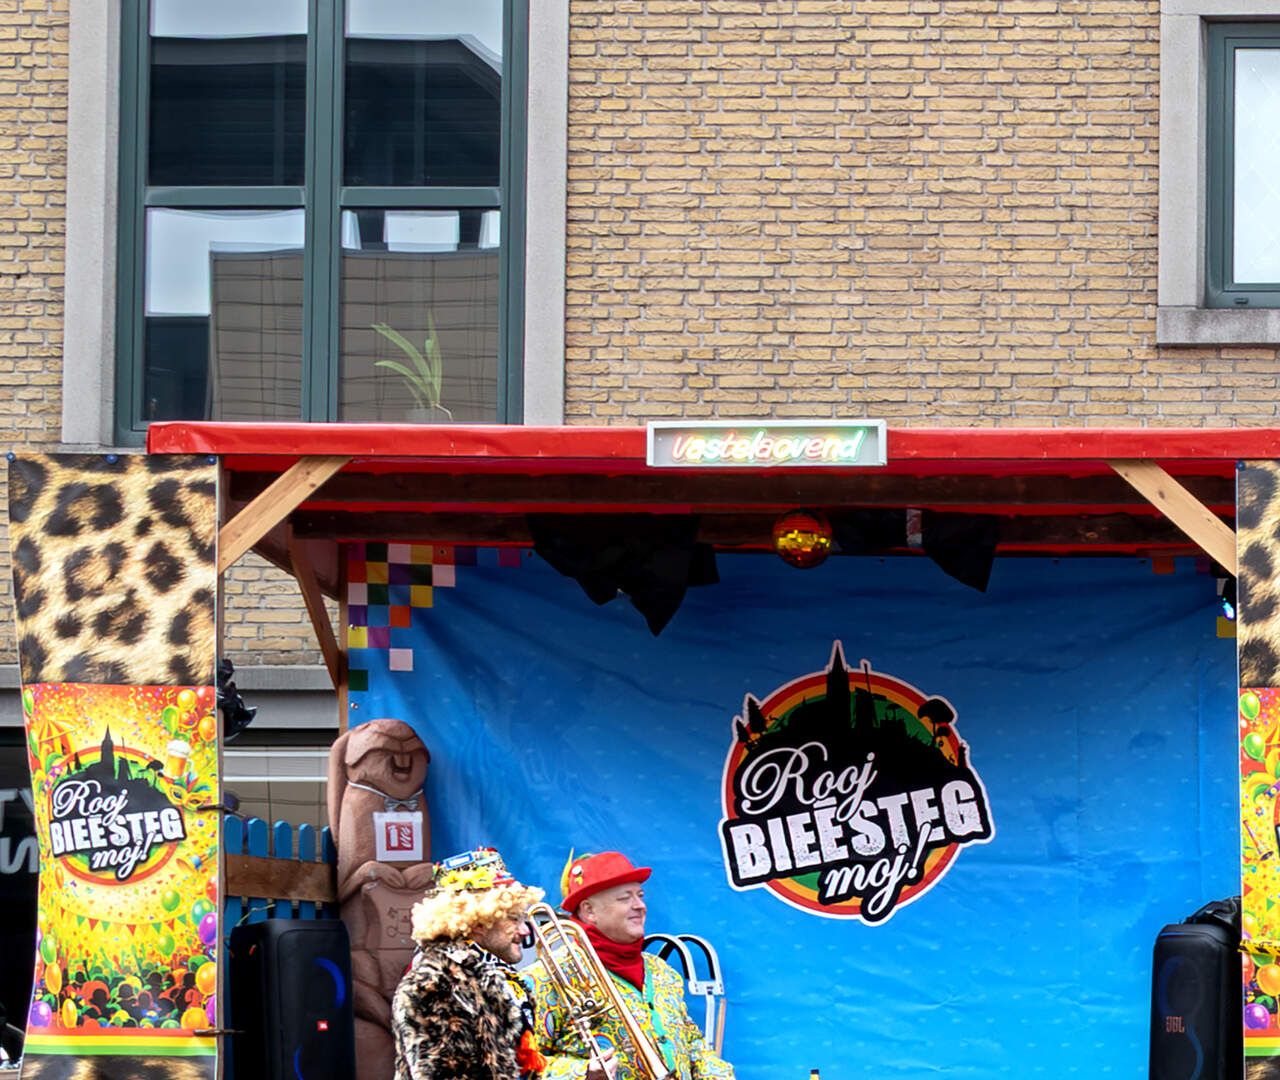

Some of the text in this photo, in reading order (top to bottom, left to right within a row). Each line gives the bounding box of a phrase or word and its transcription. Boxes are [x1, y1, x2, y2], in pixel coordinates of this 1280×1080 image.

[53, 780, 128, 826] Rooj
[741, 741, 878, 822] Rooj
[92, 831, 155, 878] moj!
[824, 822, 931, 915] moj!
